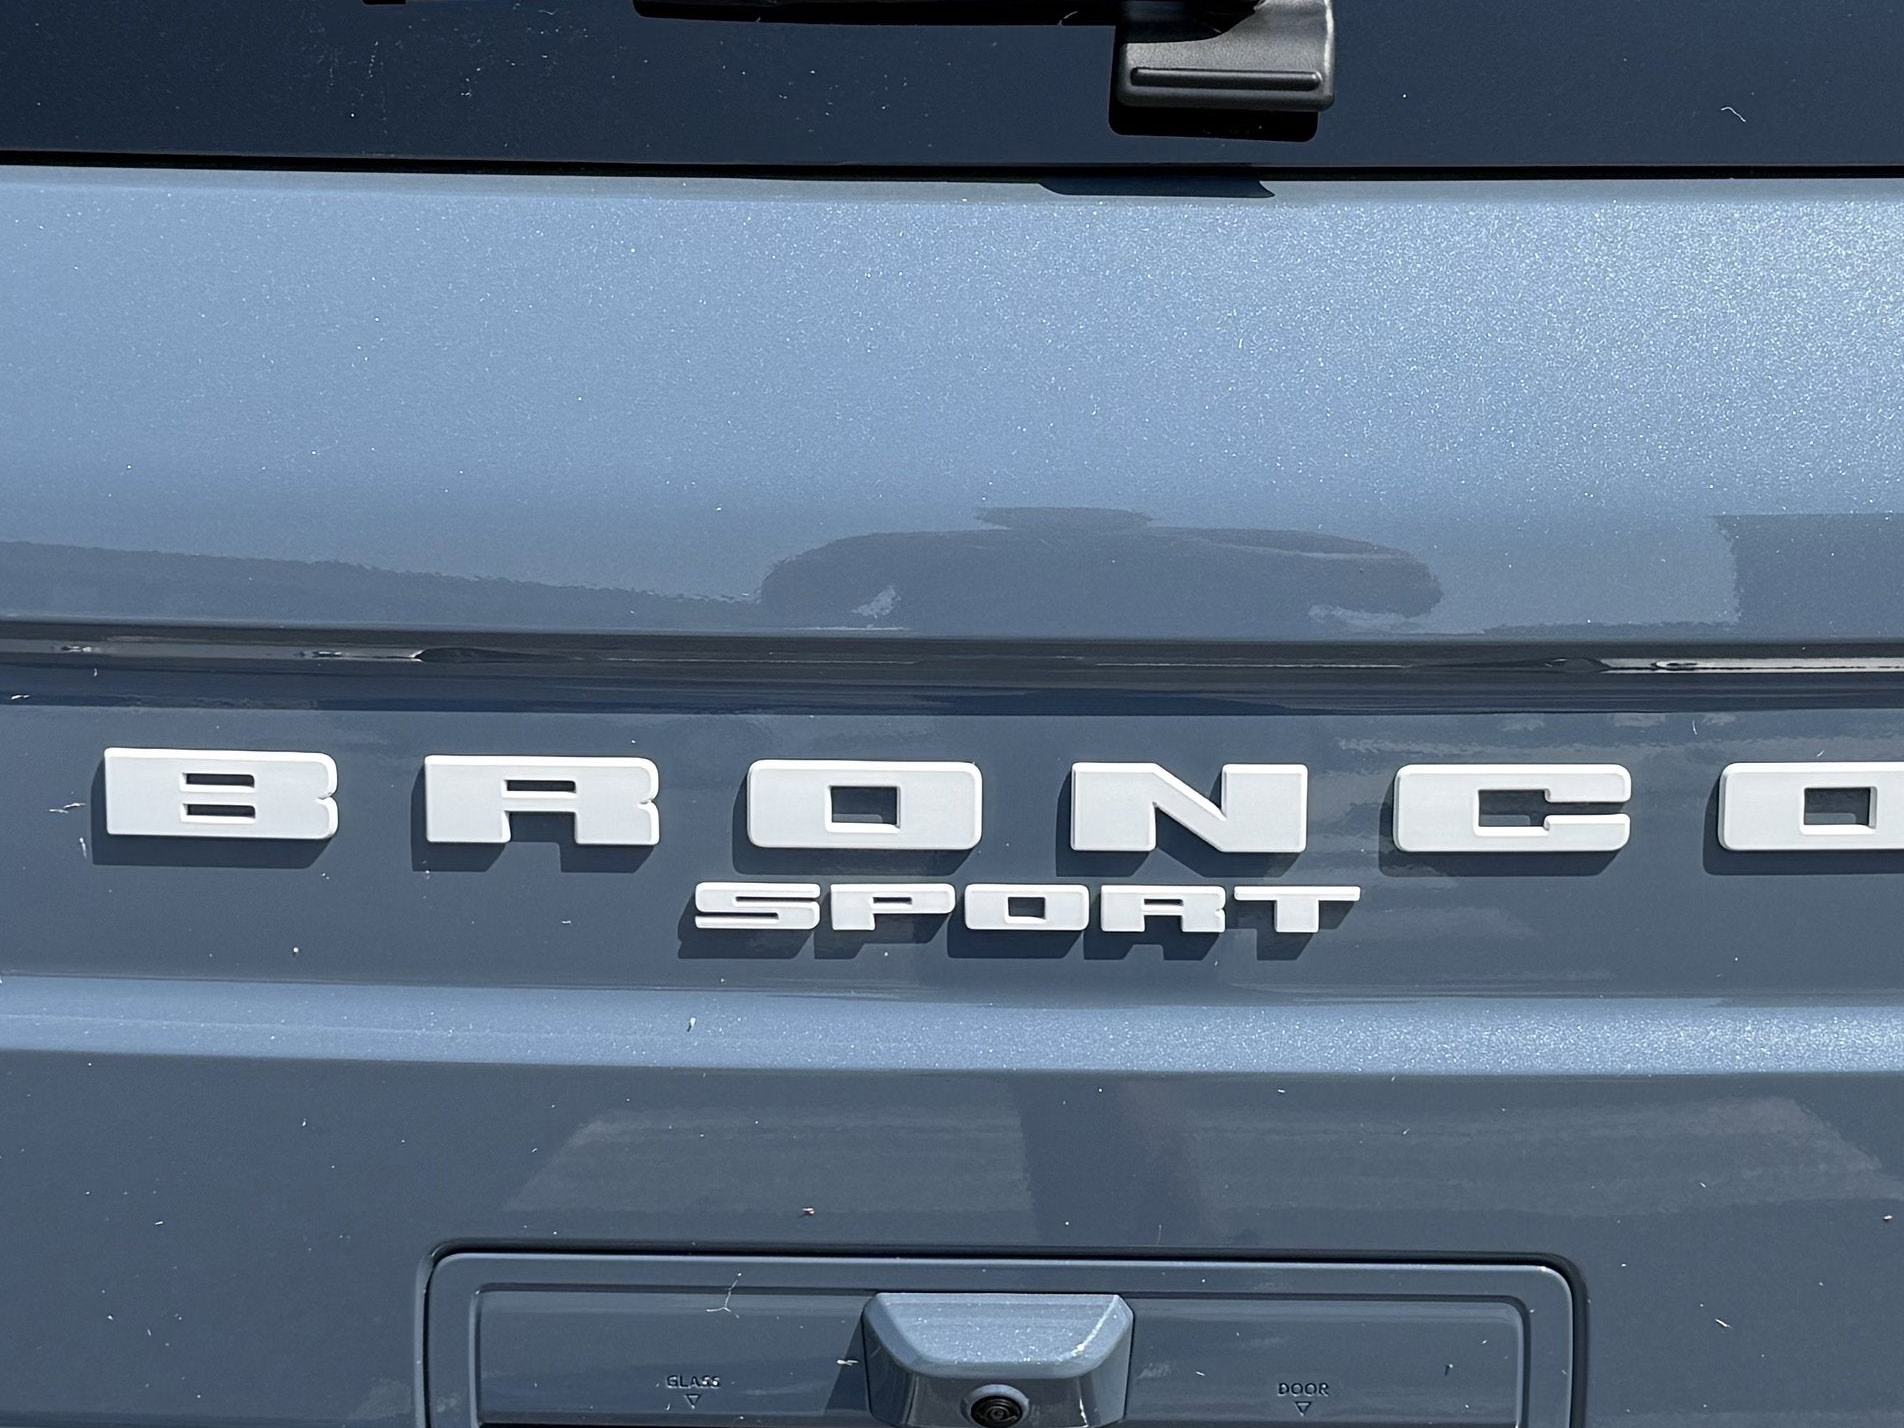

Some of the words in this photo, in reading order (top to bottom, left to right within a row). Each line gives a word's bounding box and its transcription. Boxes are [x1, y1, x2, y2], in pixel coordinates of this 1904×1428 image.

[695, 882, 1361, 933] SPORT
[666, 1374, 721, 1389] GLASS
[1277, 1382, 1329, 1397] DOOR
